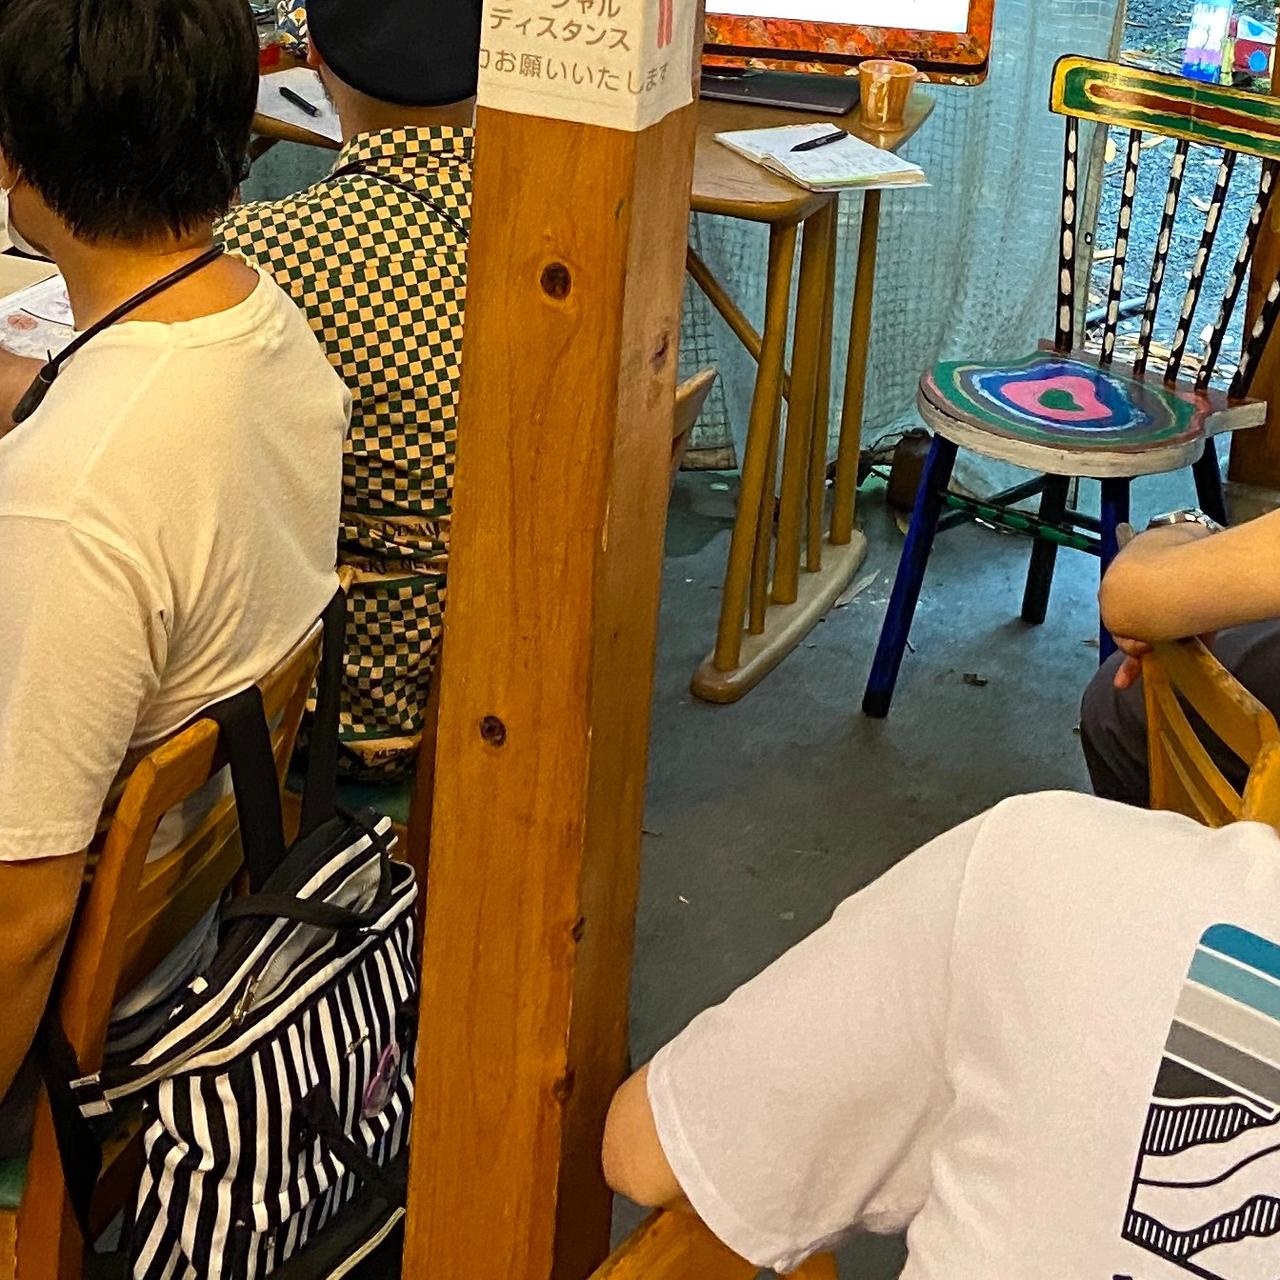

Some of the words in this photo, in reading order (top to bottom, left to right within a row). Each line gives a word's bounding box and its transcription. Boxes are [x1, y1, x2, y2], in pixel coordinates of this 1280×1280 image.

[489, 7, 631, 52] ディスタンス
